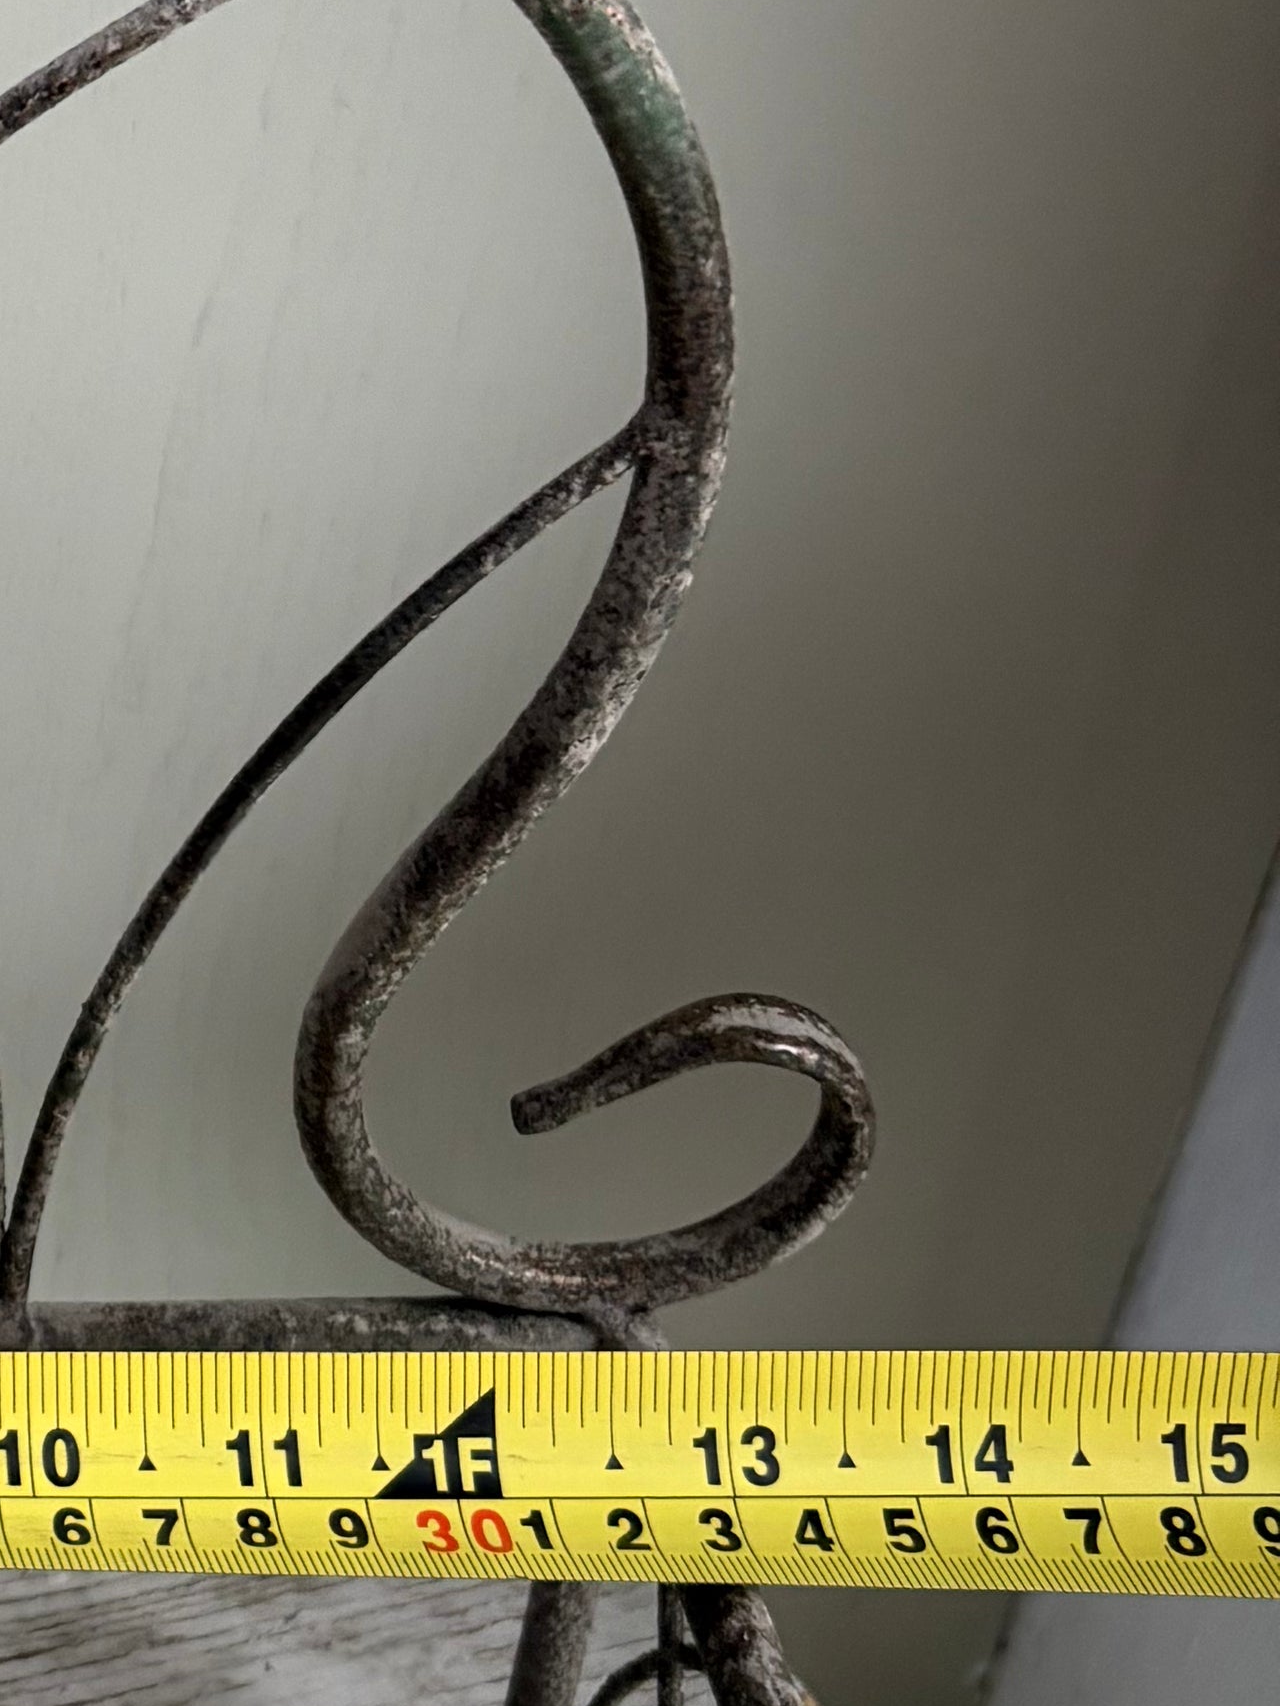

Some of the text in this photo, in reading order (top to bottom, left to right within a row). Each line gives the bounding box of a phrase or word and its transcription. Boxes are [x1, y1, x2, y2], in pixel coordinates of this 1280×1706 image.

[226, 1429, 302, 1487] 11
[421, 1436, 494, 1492] 1F
[692, 1425, 780, 1486] 13
[925, 1424, 1014, 1484] 14
[1161, 1423, 1249, 1484] 15
[53, 1508, 91, 1546] 6
[142, 1509, 179, 1546] 7
[235, 1508, 277, 1548] 8
[328, 1508, 369, 1549] 9
[416, 1509, 513, 1553] 30
[520, 1509, 553, 1550] 1
[607, 1508, 652, 1551] 2
[698, 1508, 741, 1552] 3
[795, 1508, 834, 1552] 4
[882, 1508, 927, 1553] 5
[975, 1507, 1019, 1554] 6
[1063, 1507, 1102, 1554] 7
[1160, 1506, 1207, 1556] 8
